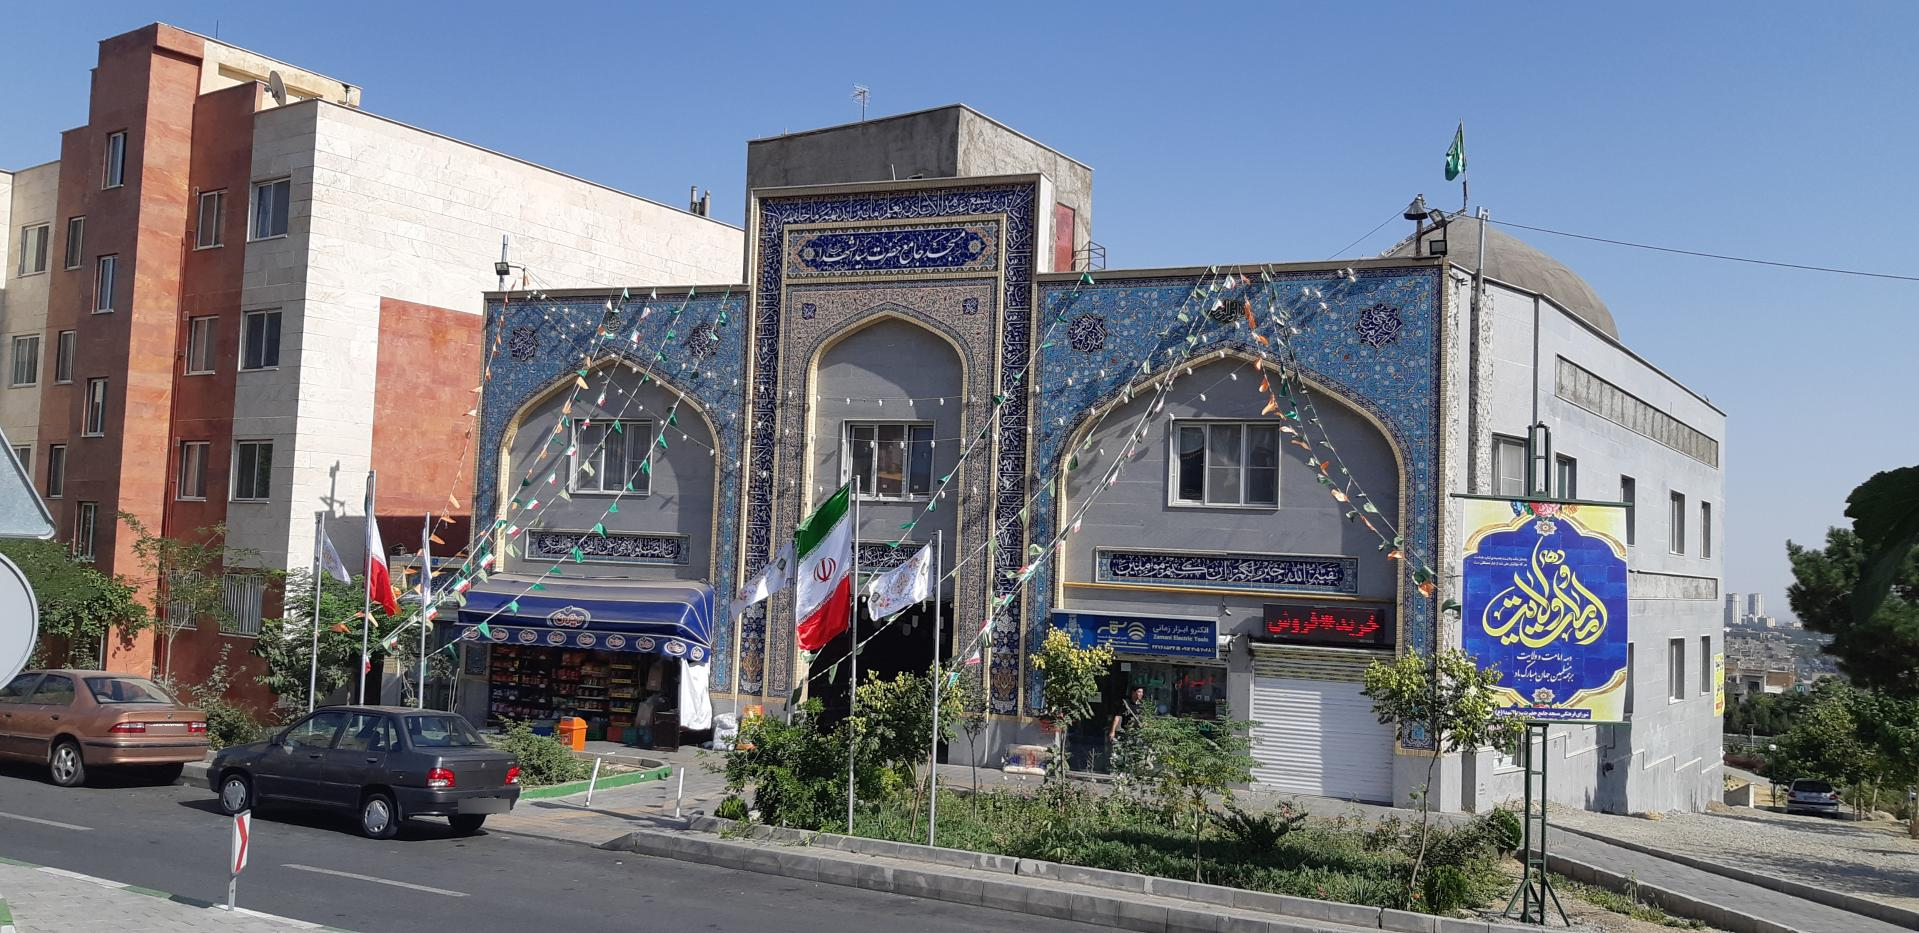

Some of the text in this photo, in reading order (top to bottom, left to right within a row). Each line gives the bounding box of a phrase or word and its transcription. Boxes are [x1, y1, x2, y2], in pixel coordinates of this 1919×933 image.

[868, 236, 902, 264] حضرت
[922, 230, 966, 260] مسجد
[899, 236, 923, 266] جامع
[1152, 624, 1171, 634] زمانی
[1172, 624, 1189, 634] ابزار
[1542, 652, 1563, 661] امامت
[1520, 661, 1537, 682] مبارک
[1536, 670, 1550, 682] جهان
[1537, 709, 1548, 718] جامع
[1560, 710, 1578, 718] فرهنگی
[1577, 710, 1590, 718] شورای
